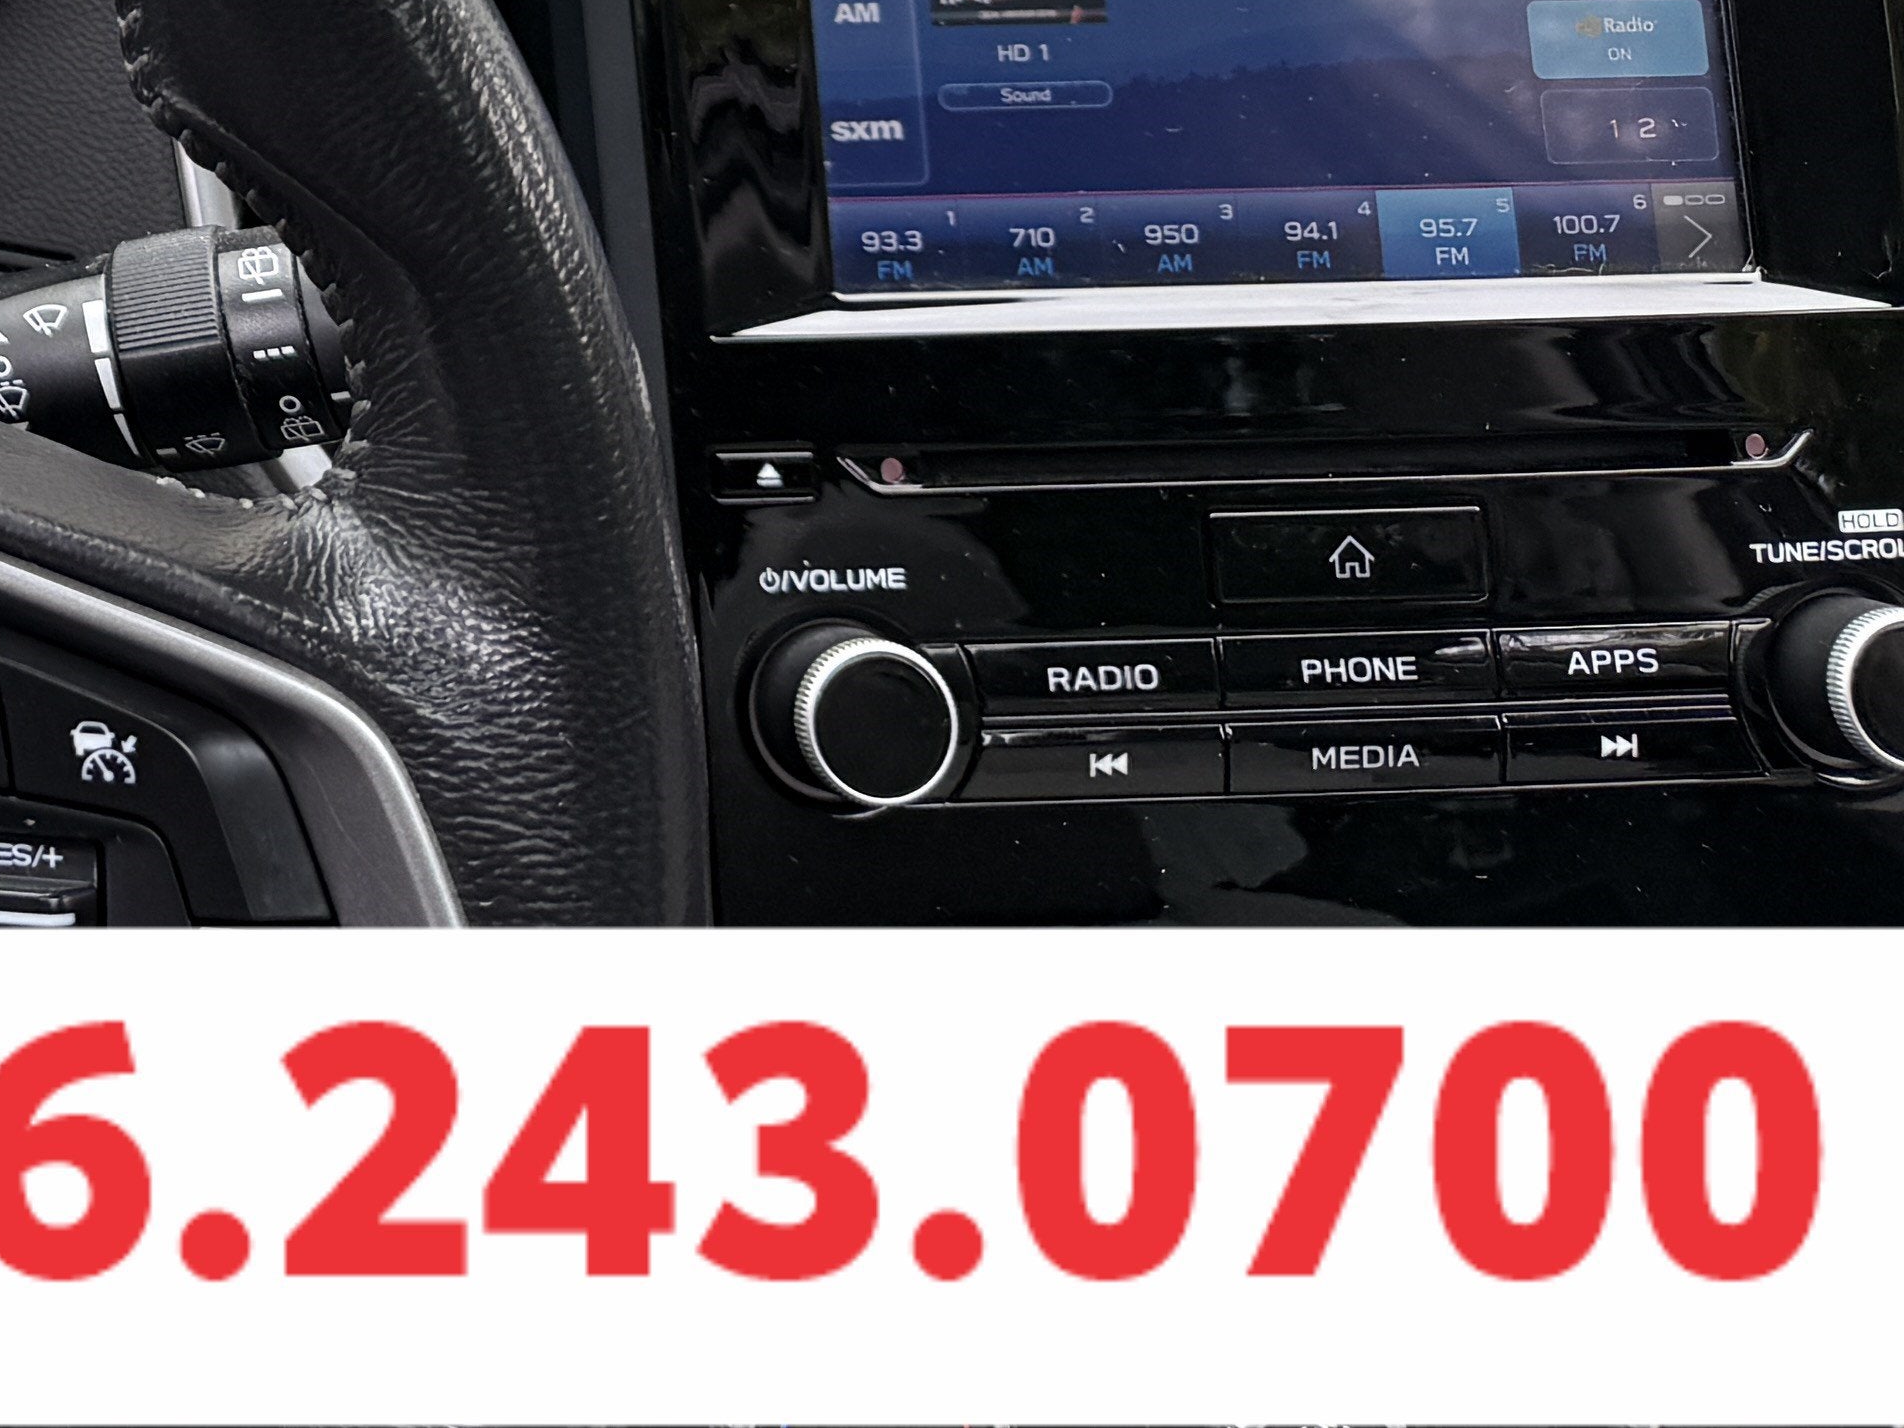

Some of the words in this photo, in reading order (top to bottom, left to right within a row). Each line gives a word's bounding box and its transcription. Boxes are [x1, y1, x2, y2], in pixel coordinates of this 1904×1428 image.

[834, 1, 880, 24] AM
[1603, 16, 1654, 33] Radio
[997, 44, 1031, 62] HD
[1039, 43, 1050, 62] 1
[1608, 47, 1632, 61] ON
[1000, 86, 1052, 104] Sound
[830, 118, 904, 143] sxm
[1638, 117, 1657, 139] 2
[1218, 203, 1234, 221] 3
[1356, 201, 1371, 217] 4
[1495, 197, 1510, 214] 5
[1632, 194, 1647, 211] 6
[945, 210, 956, 227] 1
[1079, 206, 1095, 224] 2
[1553, 214, 1621, 235] 100.7
[1143, 223, 1200, 245] 950
[1284, 220, 1339, 242] 94.1
[1419, 217, 1478, 238] 95.7
[861, 230, 923, 253] 93.3
[1009, 227, 1056, 249] 710
[1157, 253, 1193, 274] AM
[1296, 250, 1331, 270] FM
[1435, 246, 1469, 266] FM
[1574, 244, 1607, 263] FM
[877, 260, 913, 281] FM
[1017, 257, 1053, 277] AM
[1842, 512, 1900, 530] HOLD
[1301, 655, 1419, 684] PHONE
[1567, 647, 1659, 676] APPS
[1047, 663, 1160, 692] RADIO
[1311, 744, 1420, 770] MEDIA
